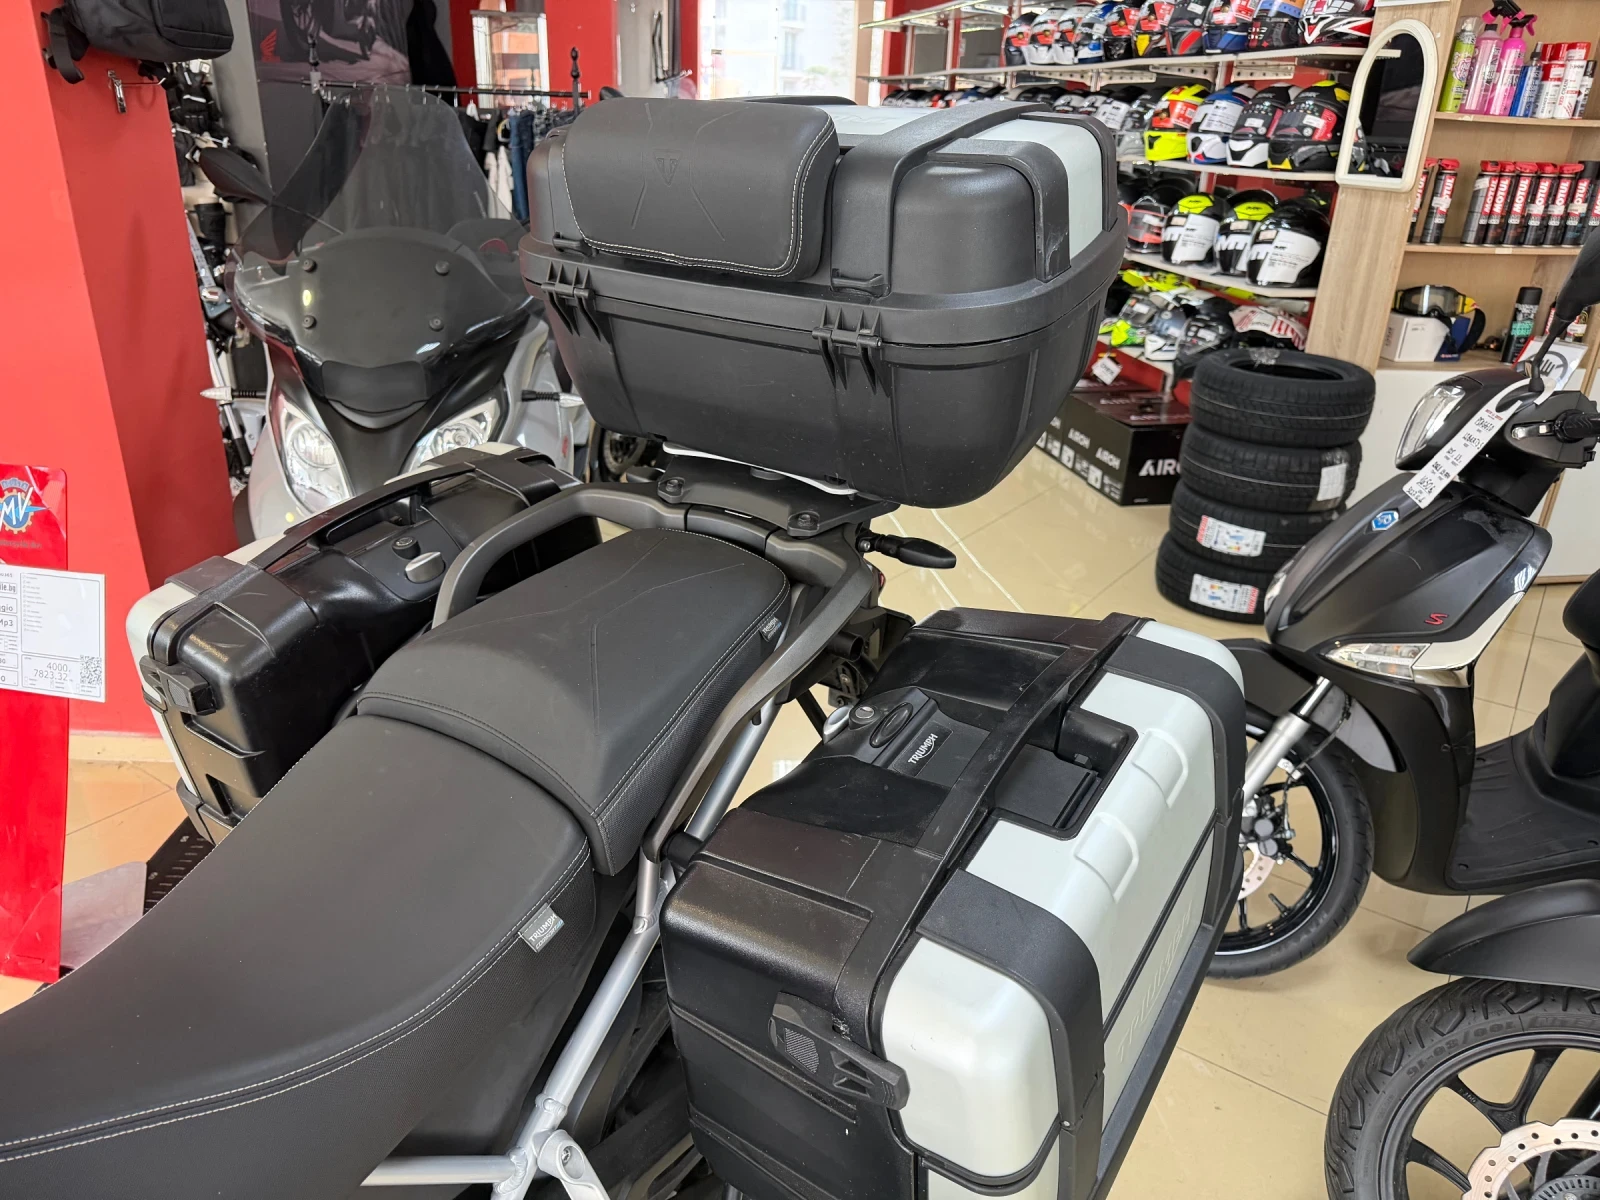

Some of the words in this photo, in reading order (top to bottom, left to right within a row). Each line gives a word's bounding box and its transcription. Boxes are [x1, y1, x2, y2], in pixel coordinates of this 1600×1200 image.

[1484, 178, 1499, 214] MOTUL
[1493, 178, 1510, 214] MOTUL
[1513, 178, 1530, 214] MOTUL
[1534, 180, 1550, 207] OTUL
[1554, 180, 1570, 207] OTUL
[1068, 428, 1091, 449] AIROH
[1095, 447, 1121, 470] AIROH
[1425, 612, 1448, 626] S
[908, 733, 939, 765] TRIUMPH
[528, 913, 558, 943] TRIUMPH
